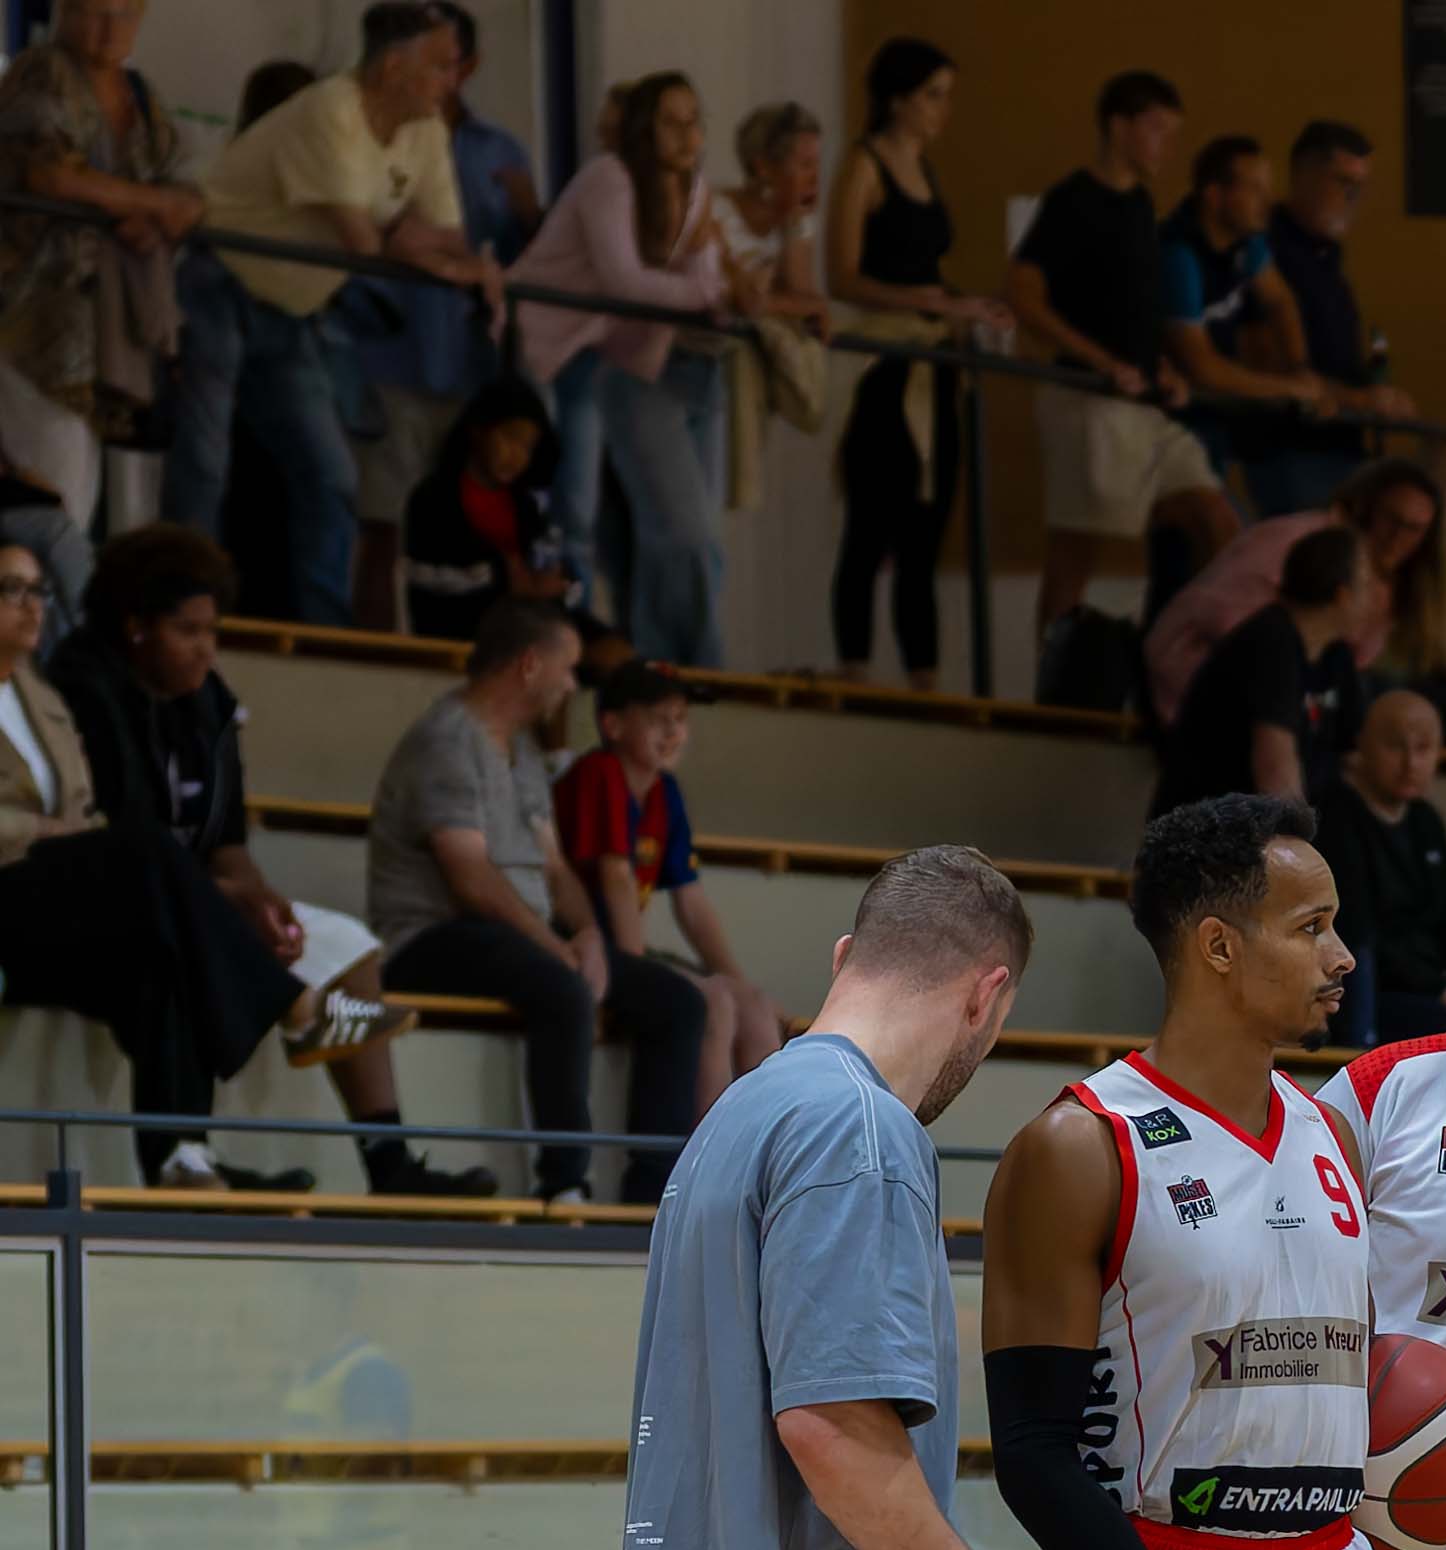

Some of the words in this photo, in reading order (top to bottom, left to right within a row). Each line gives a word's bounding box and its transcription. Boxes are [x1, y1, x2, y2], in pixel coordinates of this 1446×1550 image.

[1145, 1126, 1181, 1141] KOX
[1313, 1154, 1361, 1238] 9
[1240, 1326, 1318, 1353] Fabrice
[1240, 1361, 1319, 1380] Immobilier
